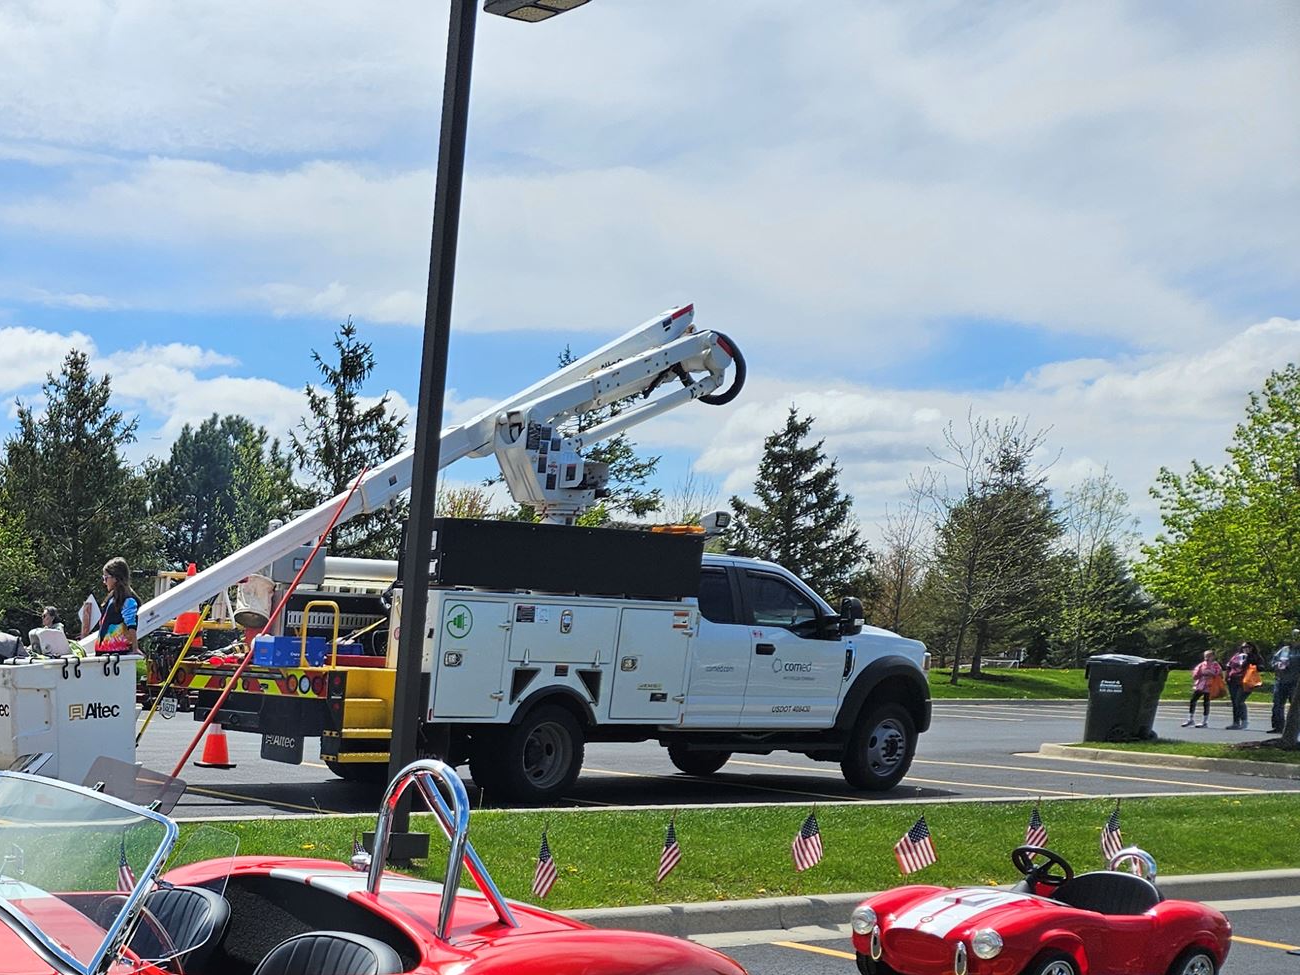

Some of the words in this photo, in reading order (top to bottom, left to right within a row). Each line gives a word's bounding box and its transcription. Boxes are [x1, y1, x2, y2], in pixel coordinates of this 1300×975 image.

[784, 661, 812, 672] comed
[85, 702, 120, 720] Altec
[772, 705, 792, 713] USDOT
[273, 735, 296, 749] Altec
